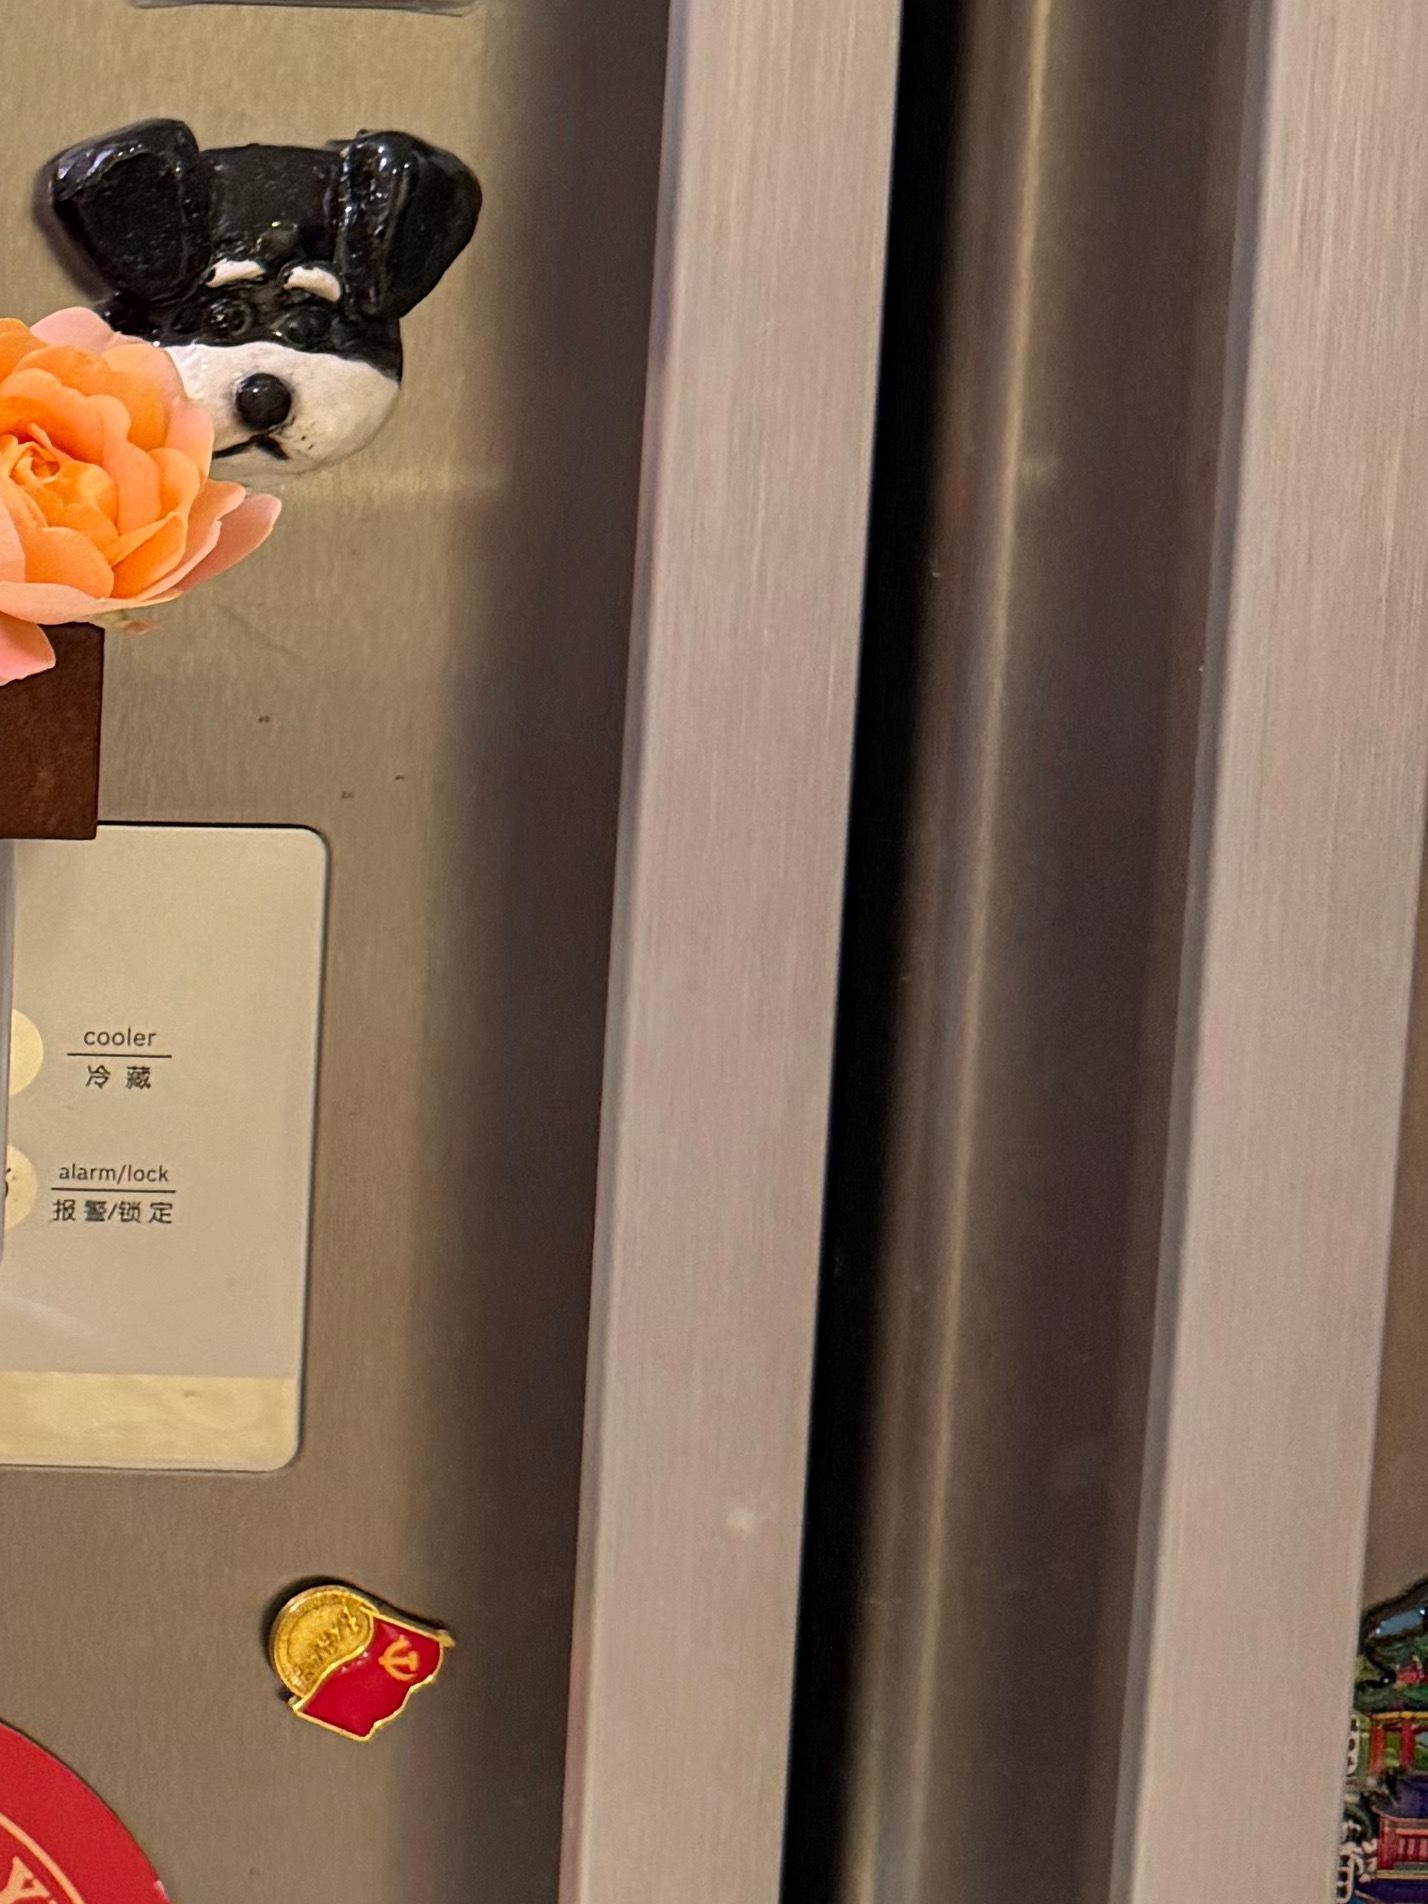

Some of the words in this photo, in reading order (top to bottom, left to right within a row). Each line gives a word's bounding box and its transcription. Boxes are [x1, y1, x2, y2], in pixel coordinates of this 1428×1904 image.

[83, 1027, 157, 1047] cooler
[85, 1064, 152, 1090] 冷藏
[58, 1163, 169, 1185] alarm/lock
[52, 1198, 174, 1224] 报警/锁定
